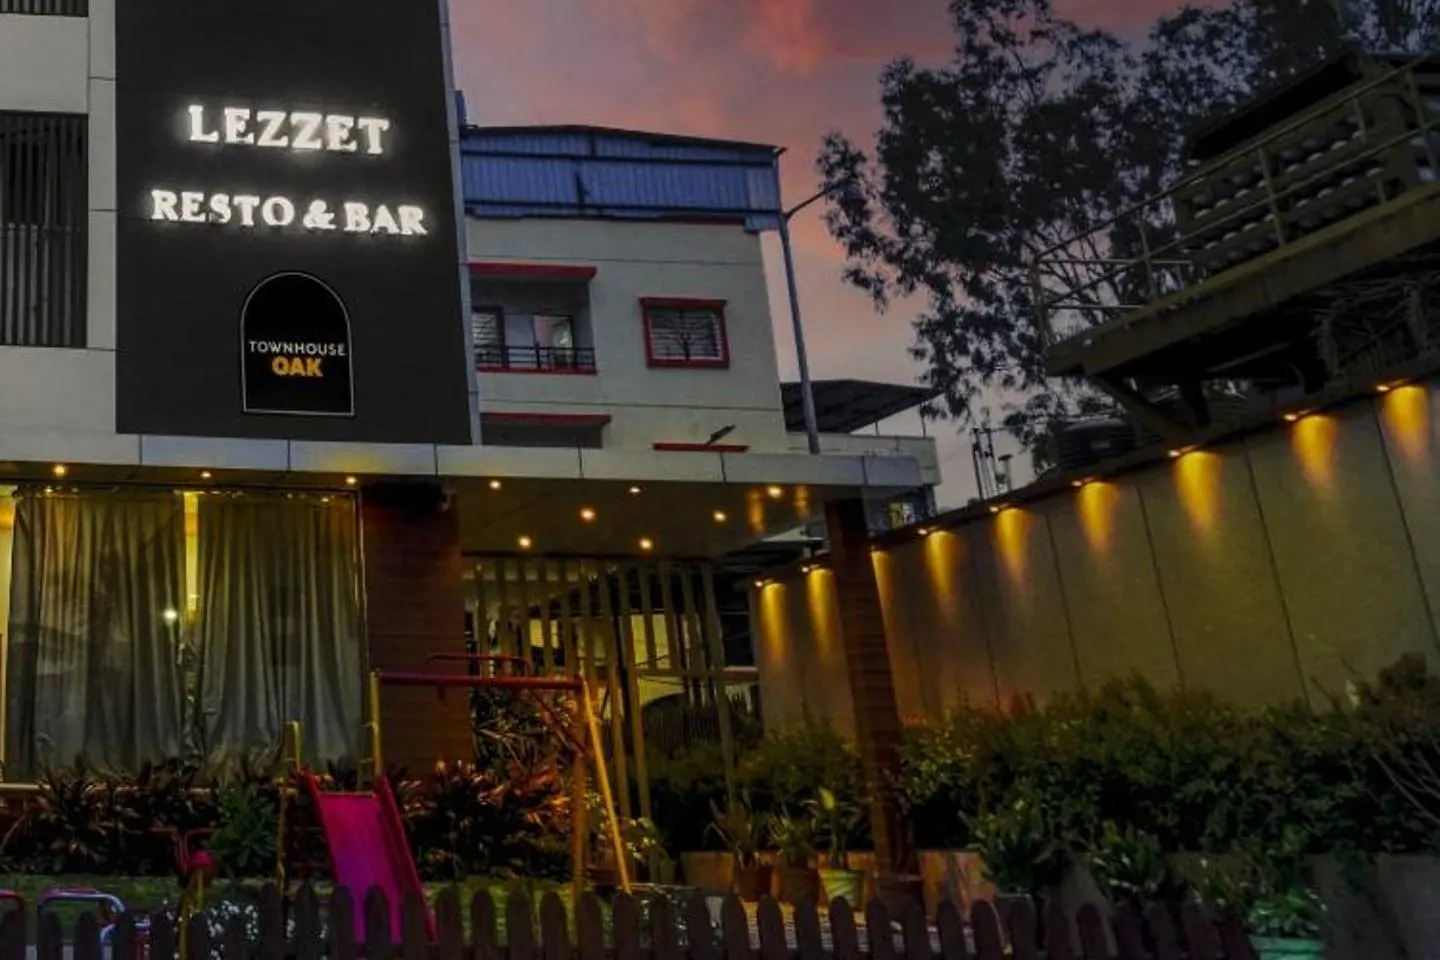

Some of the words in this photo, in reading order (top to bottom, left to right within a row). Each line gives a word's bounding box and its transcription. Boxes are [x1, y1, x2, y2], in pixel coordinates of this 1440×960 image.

[187, 104, 390, 154] LEZZET
[151, 189, 295, 227] RESTO
[302, 199, 337, 230] &
[343, 201, 428, 236] BAR
[249, 341, 346, 356] TOWNHOUSE
[272, 356, 323, 377] OAK
